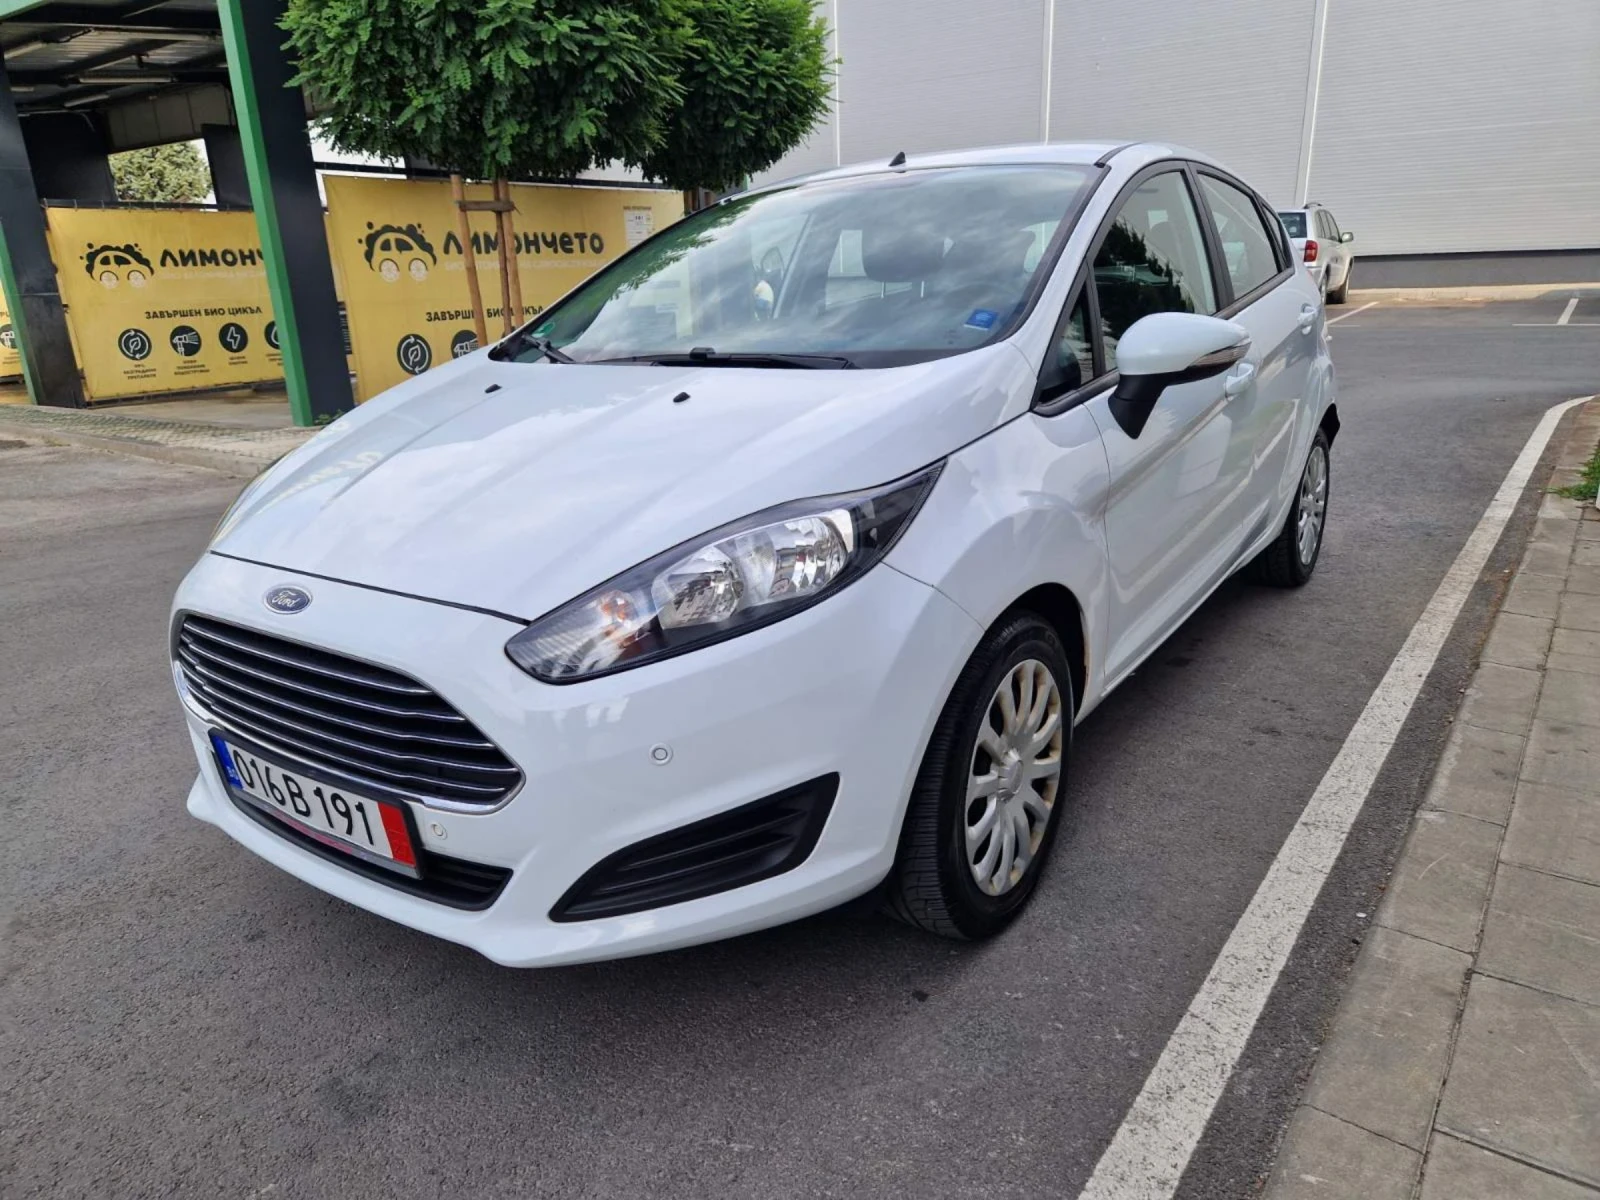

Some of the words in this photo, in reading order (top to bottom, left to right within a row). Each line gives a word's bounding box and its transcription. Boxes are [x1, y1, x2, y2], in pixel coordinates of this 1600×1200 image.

[145, 308, 201, 319] ЗАВЪРШЕН
[204, 307, 226, 317] БИО
[228, 306, 262, 316] ЦИКЪЛ
[425, 309, 475, 322] ЗАВЪРШ
[272, 590, 301, 607] Ford
